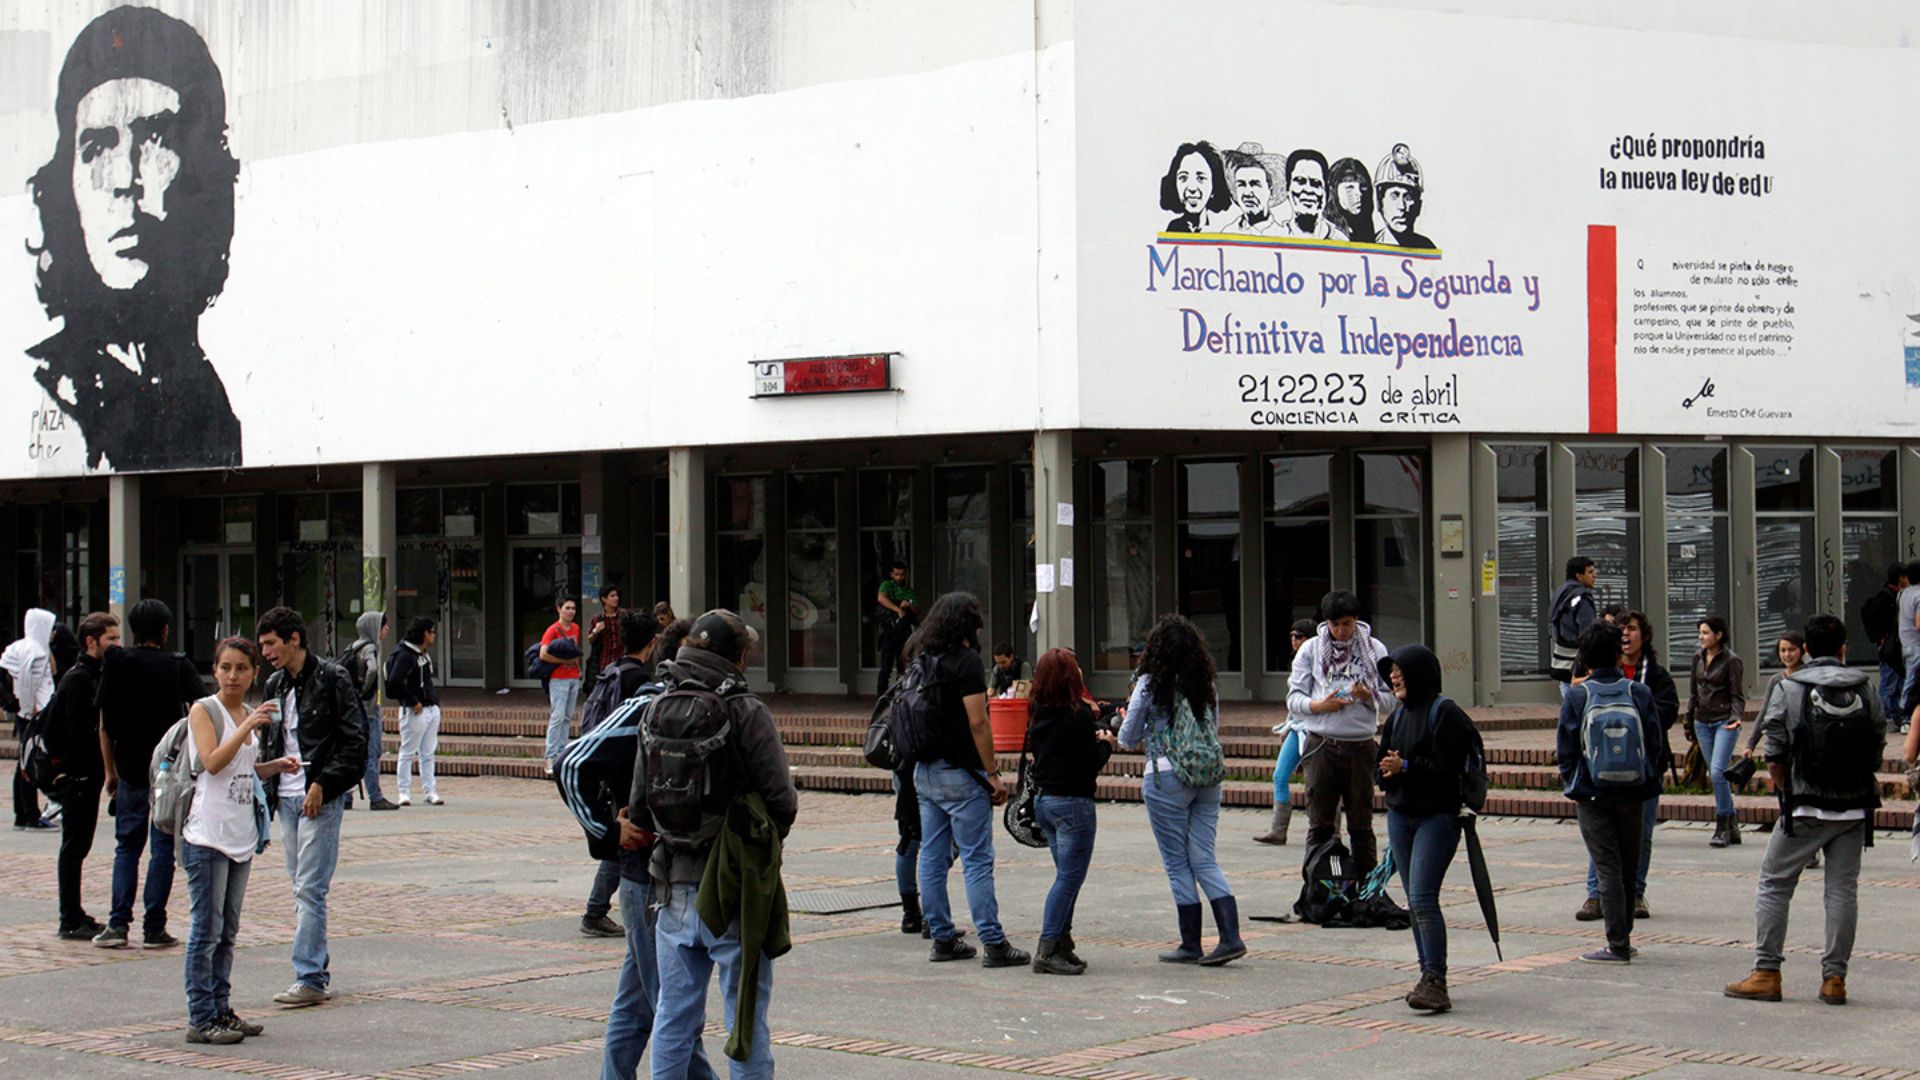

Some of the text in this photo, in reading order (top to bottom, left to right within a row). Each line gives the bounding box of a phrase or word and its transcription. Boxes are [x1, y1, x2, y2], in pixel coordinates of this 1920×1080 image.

[1610, 132, 1765, 160] ¿Qué propondría
[1600, 167, 1617, 189] la
[1621, 170, 1676, 190] nueva
[1681, 168, 1710, 194] ley
[1712, 171, 1735, 196] de
[1718, 261, 1727, 271] se
[1146, 245, 1541, 311] Marchando por la Segunda y
[1690, 275, 1700, 285] de
[1737, 278, 1749, 286] no
[1633, 288, 1645, 297] los
[1680, 304, 1696, 314] que
[1699, 304, 1707, 312] se
[1710, 304, 1732, 315] pinte
[1734, 303, 1745, 313] de
[1776, 307, 1782, 316] y
[1686, 319, 1702, 328] que
[1707, 319, 1715, 327] se
[1721, 318, 1743, 328] pinte
[1747, 318, 1758, 328] de
[1179, 307, 1524, 370] Definitiva Independencia
[1633, 332, 1663, 342] porque
[1666, 331, 1673, 340] la
[1675, 331, 1723, 341] Universidad
[1726, 333, 1736, 341] no
[1739, 333, 1747, 341] es
[1749, 332, 1756, 341] el
[1649, 345, 1660, 354] de
[1661, 345, 1685, 354] nadie
[1686, 347, 1691, 357] y
[1693, 346, 1735, 357] pertenece
[1737, 346, 1744, 355] al
[763, 382, 777, 392] 104
[1238, 373, 1459, 407] 21,22,23 de abril
[1250, 407, 1461, 426] CONCIENCIA CRÍTICA
[1707, 407, 1738, 418] Ernesto
[1758, 408, 1792, 418] Guevara
[1824, 539, 1835, 614] EDUC
